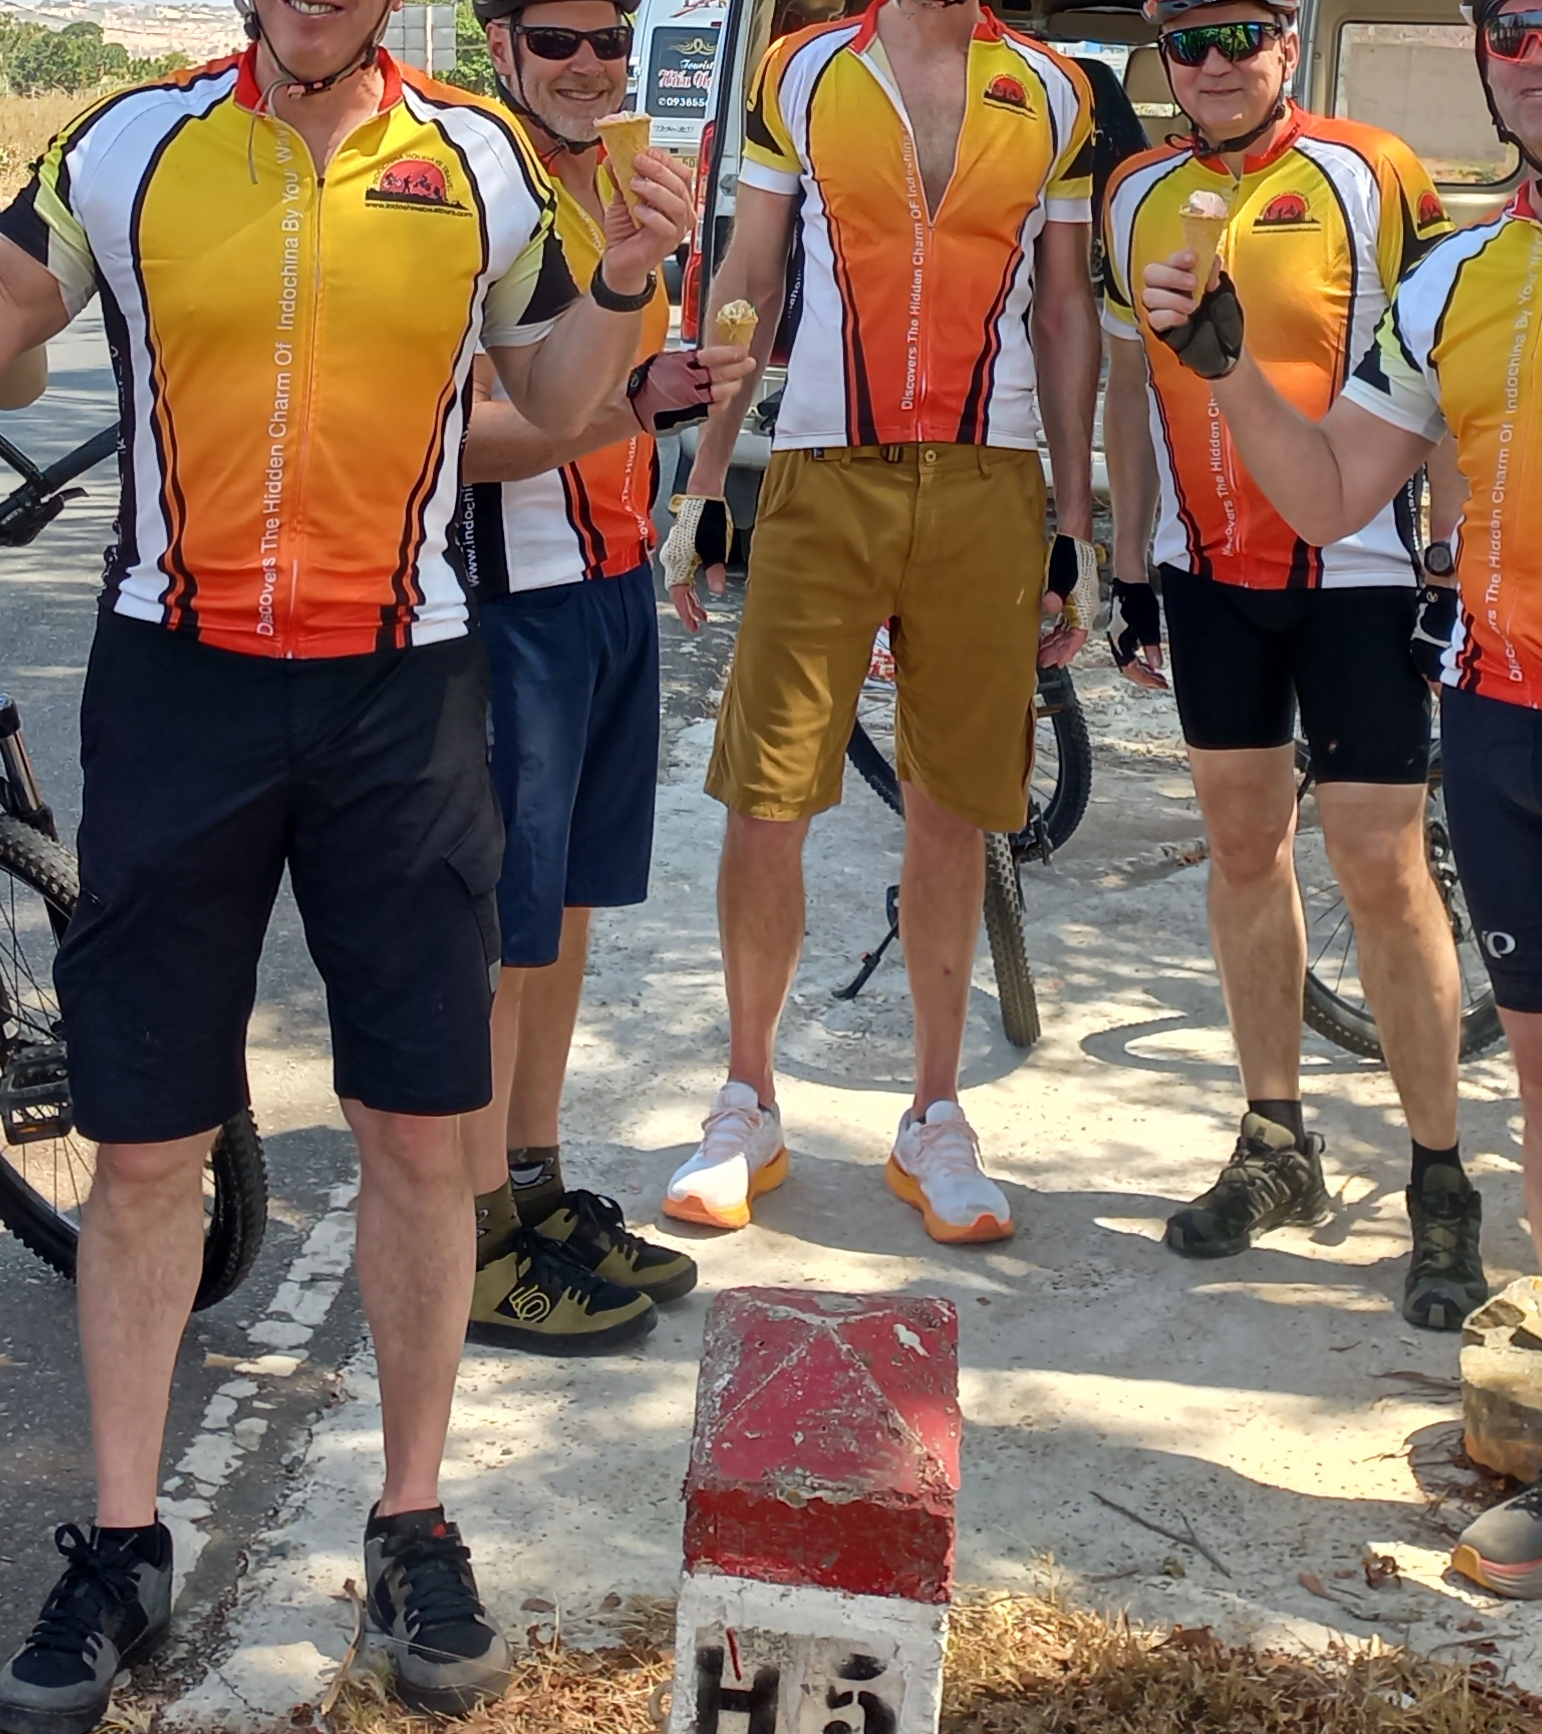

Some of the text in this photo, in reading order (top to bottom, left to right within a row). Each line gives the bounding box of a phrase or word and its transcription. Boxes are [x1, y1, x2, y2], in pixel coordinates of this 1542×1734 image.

[281, 208, 304, 232] By
[911, 222, 925, 266] Charm
[275, 243, 300, 332] Indochina
[909, 267, 924, 317] Hidden
[273, 342, 294, 367] Of
[906, 319, 920, 343] The
[1504, 333, 1527, 415] Indochina
[267, 372, 292, 439] Charm
[1210, 420, 1222, 472] Hidden
[262, 444, 285, 515] Hidden
[1491, 447, 1509, 505] Charm
[260, 519, 280, 555] The
[1488, 508, 1503, 570] Hidden
[256, 557, 277, 637] Discovers
[1486, 577, 1502, 605] The
